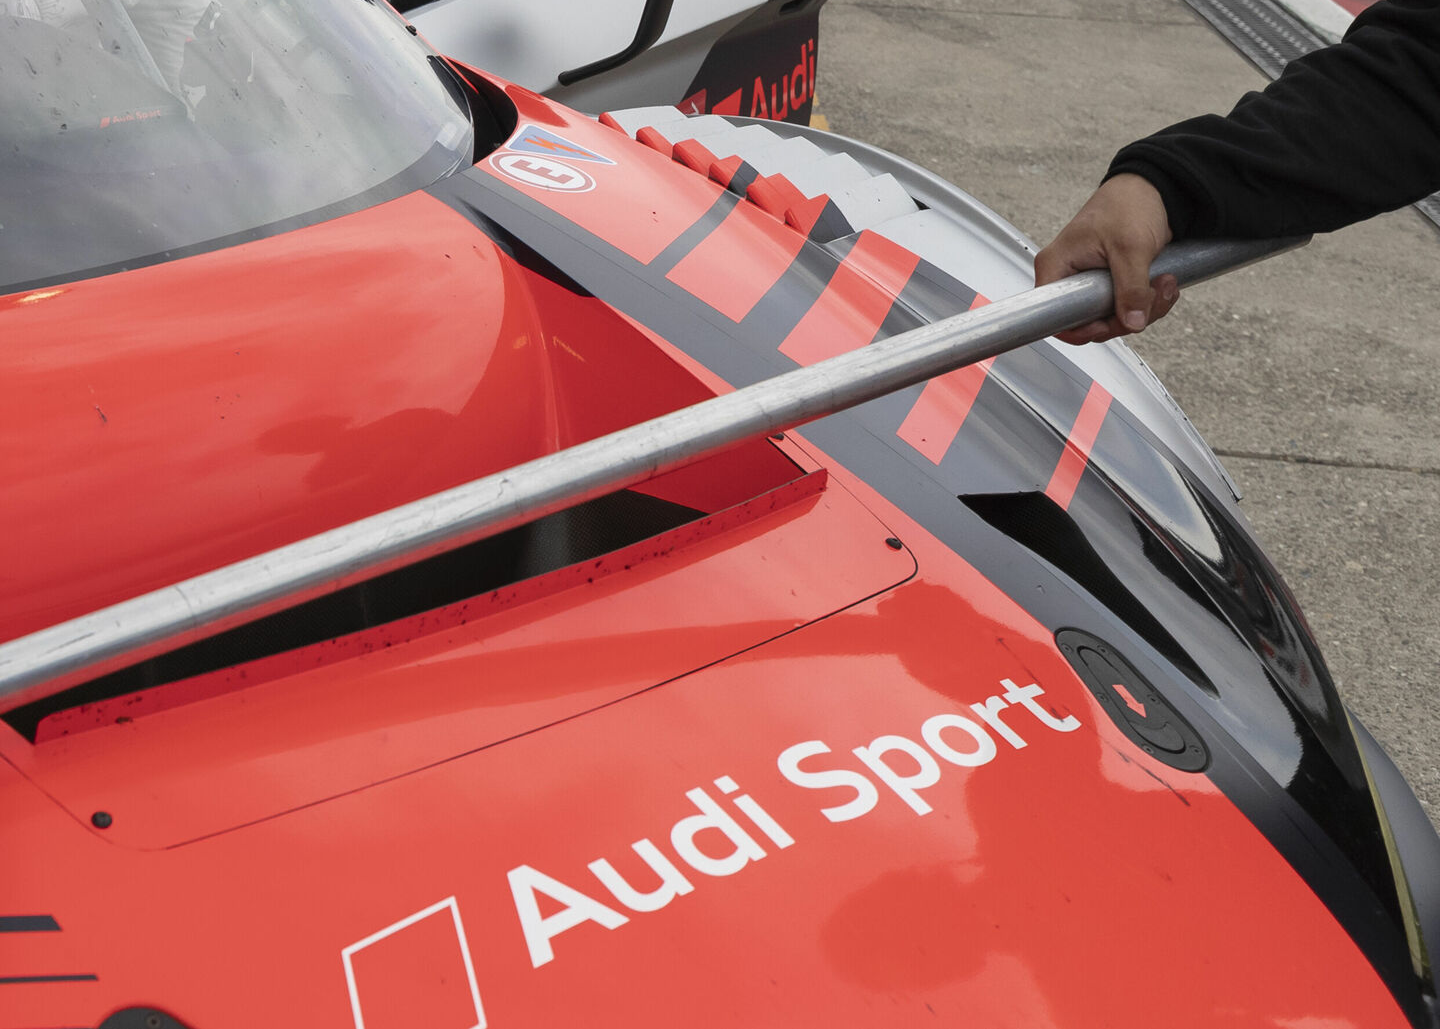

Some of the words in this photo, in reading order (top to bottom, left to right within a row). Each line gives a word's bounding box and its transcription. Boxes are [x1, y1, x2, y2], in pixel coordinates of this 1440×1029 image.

[750, 38, 815, 122] Audi
[505, 775, 793, 969] Audi
[776, 676, 1083, 825] Sport
